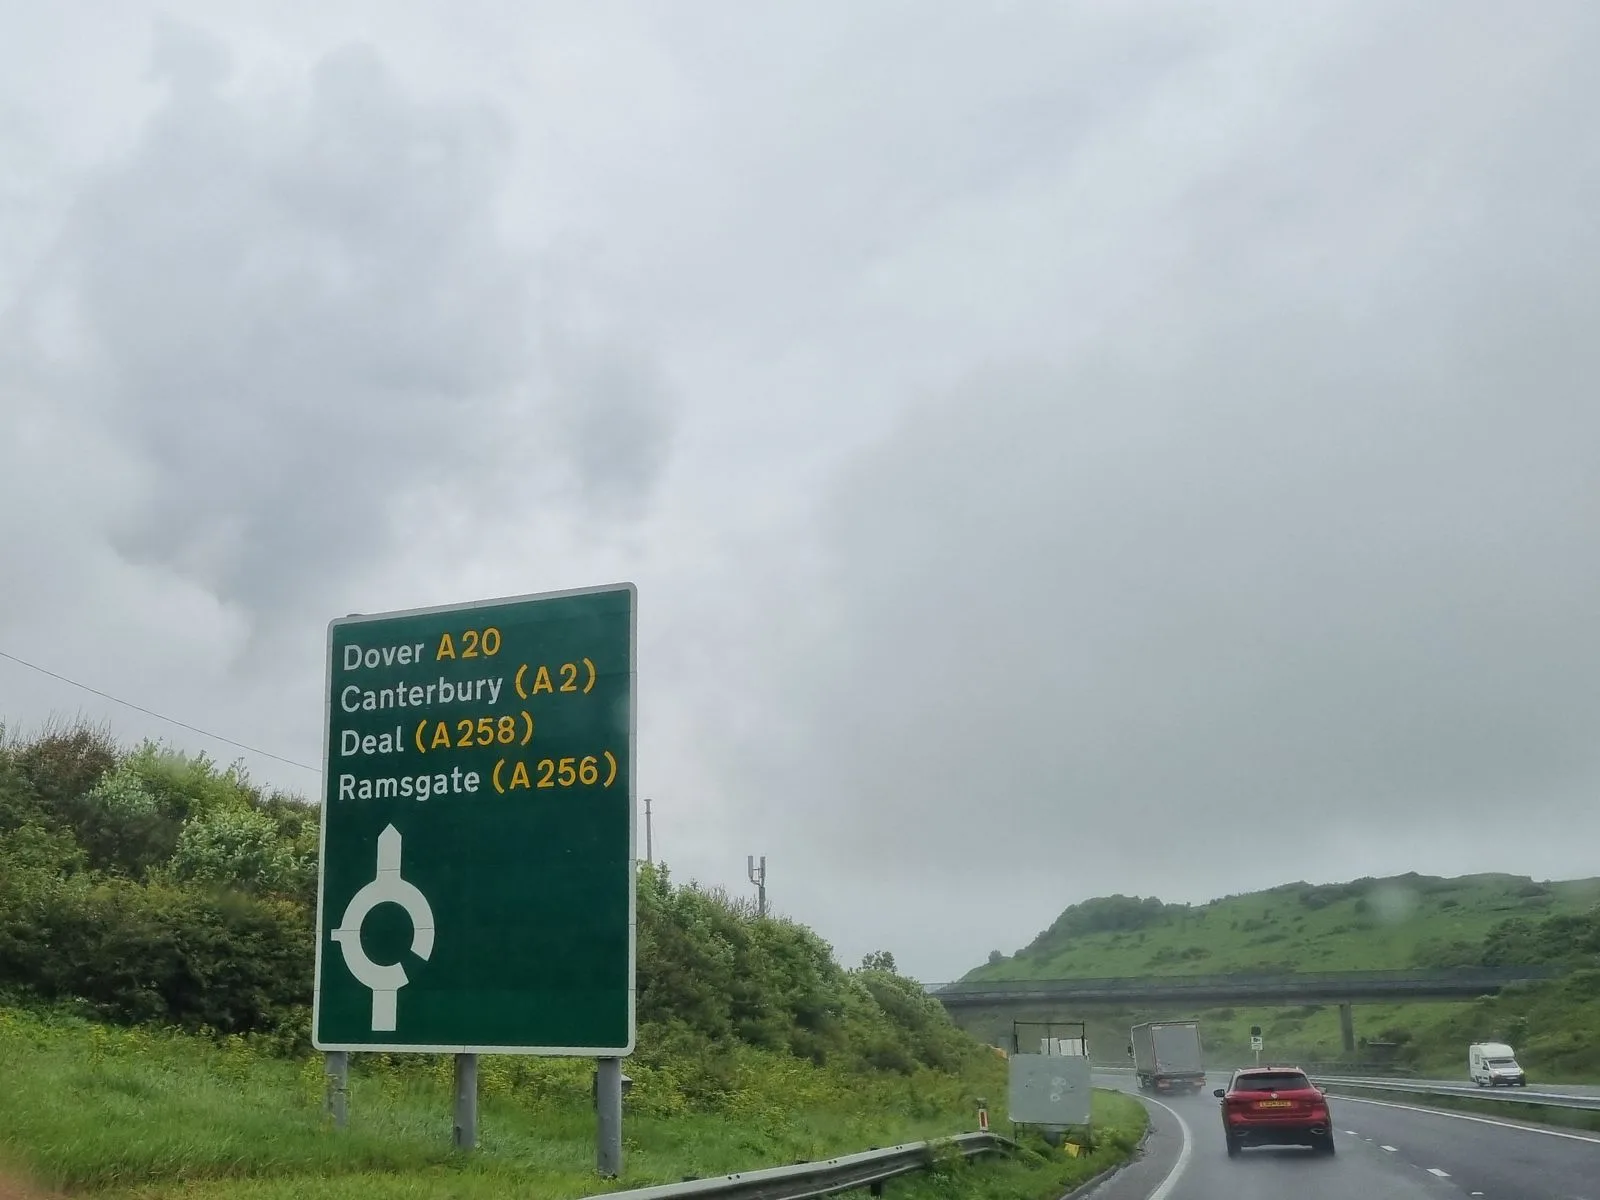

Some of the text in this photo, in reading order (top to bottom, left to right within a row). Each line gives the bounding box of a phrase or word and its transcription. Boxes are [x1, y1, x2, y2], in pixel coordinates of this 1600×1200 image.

[343, 643, 424, 671] Dover
[341, 677, 503, 713] Canterbury
[341, 725, 405, 757] Deal
[338, 765, 481, 802] Ramsgate
